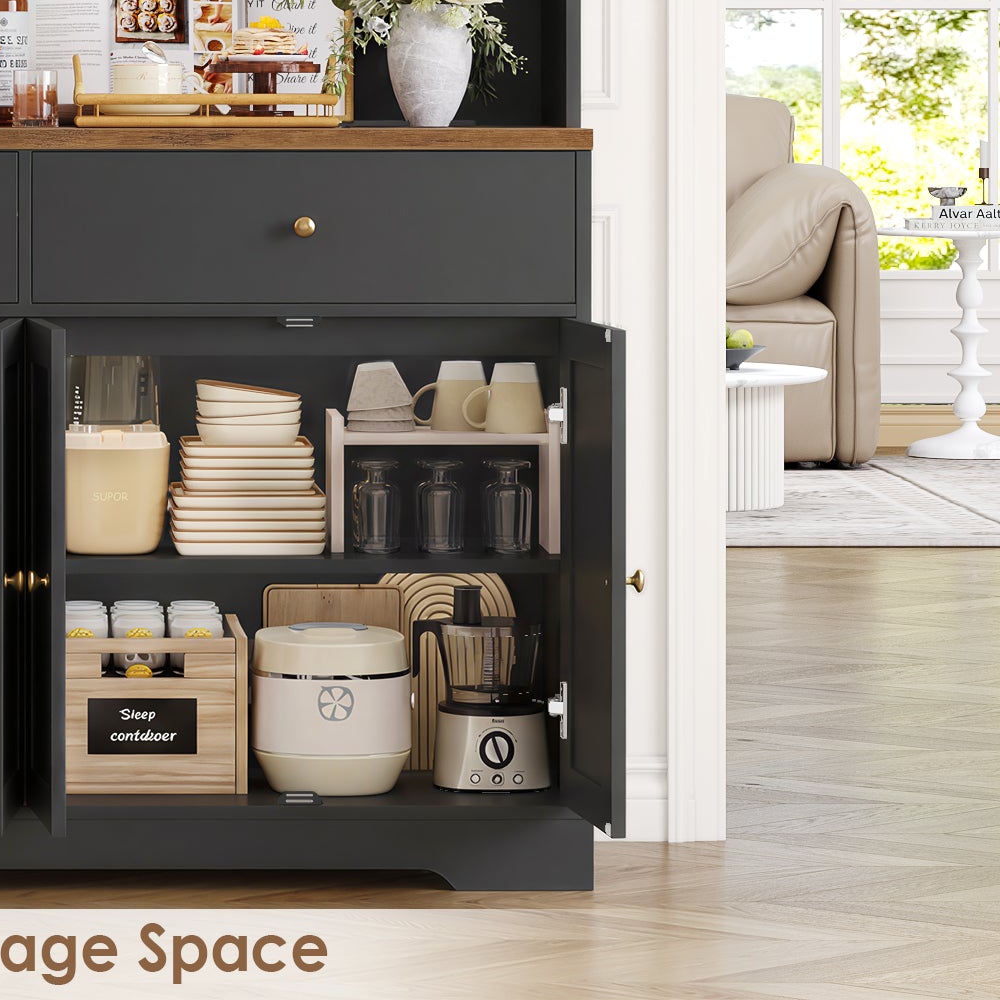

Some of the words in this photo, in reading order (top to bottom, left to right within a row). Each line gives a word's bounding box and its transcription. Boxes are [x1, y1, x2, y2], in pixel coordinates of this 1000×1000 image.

[256, 0, 265, 8] IT
[308, 22, 318, 35] it
[308, 47, 318, 59] it
[938, 208, 974, 219] Alvar
[914, 222, 946, 230] KERRY
[950, 222, 979, 230] JOYCE
[92, 490, 129, 502] SUPOR
[119, 708, 156, 722] Sleep
